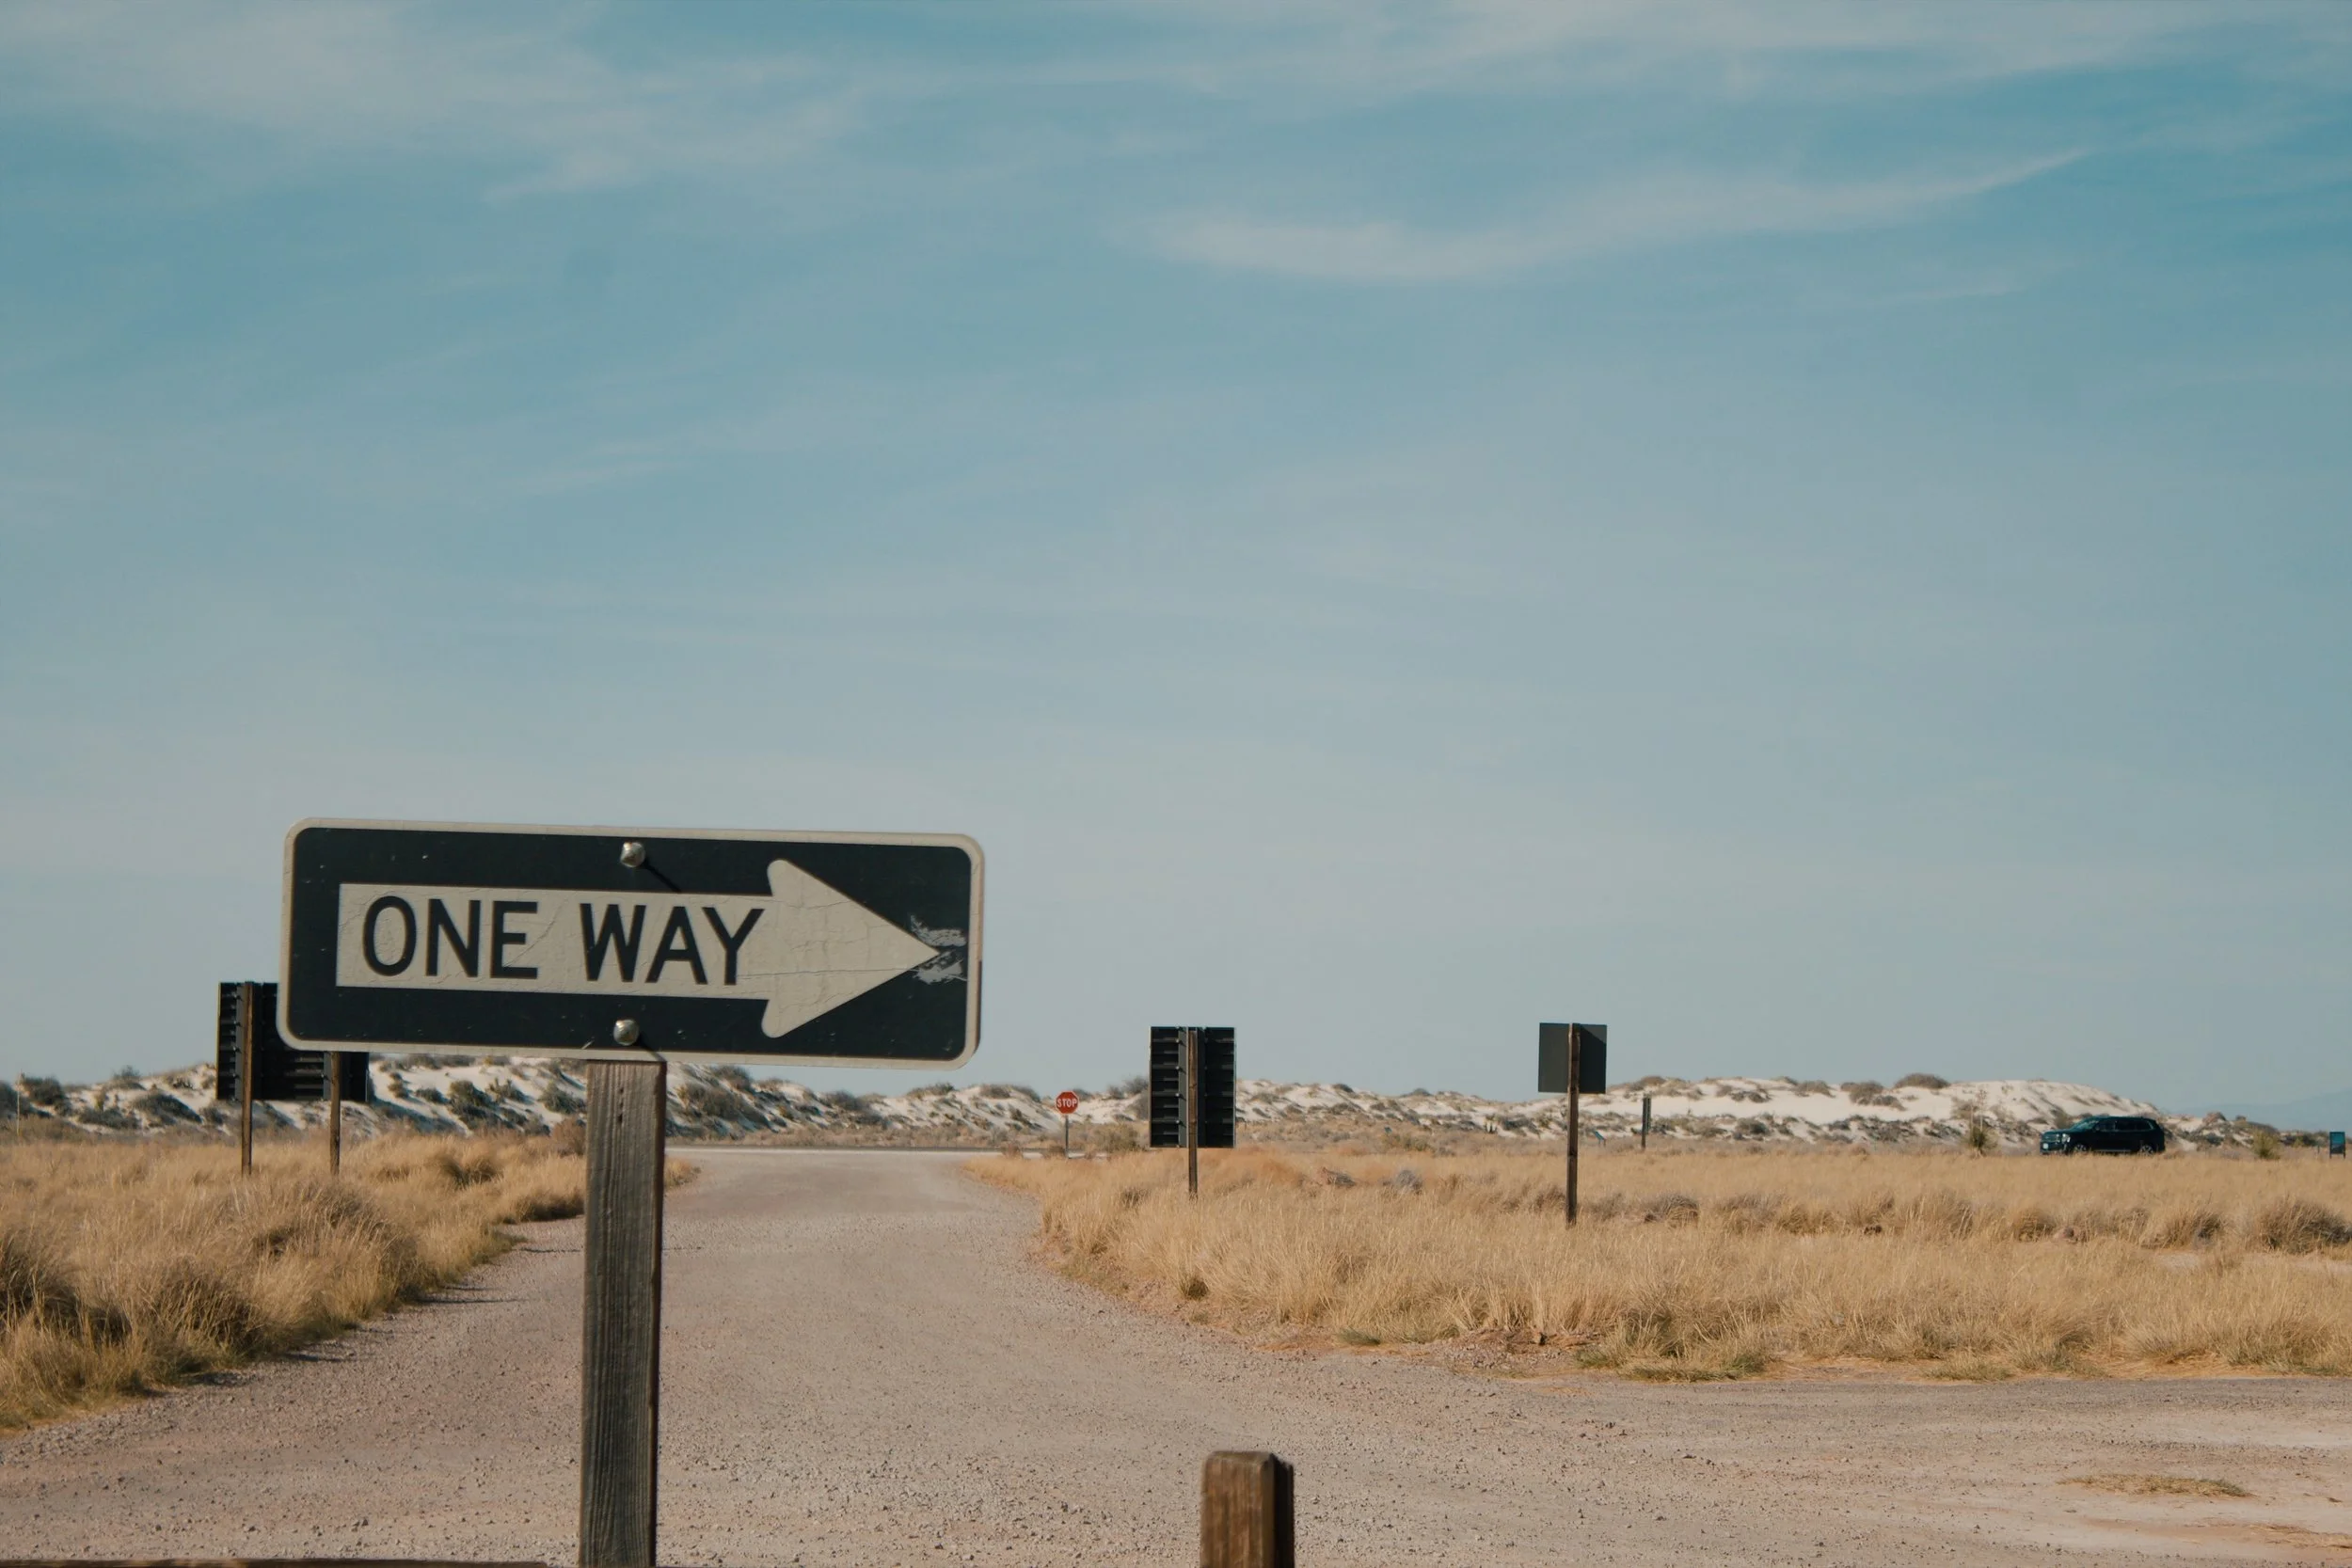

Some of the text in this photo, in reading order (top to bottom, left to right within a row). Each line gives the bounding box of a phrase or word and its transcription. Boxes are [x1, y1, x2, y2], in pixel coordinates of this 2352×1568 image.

[363, 895, 765, 986] ONE WAY
[1057, 1099, 1077, 1107] STOP
